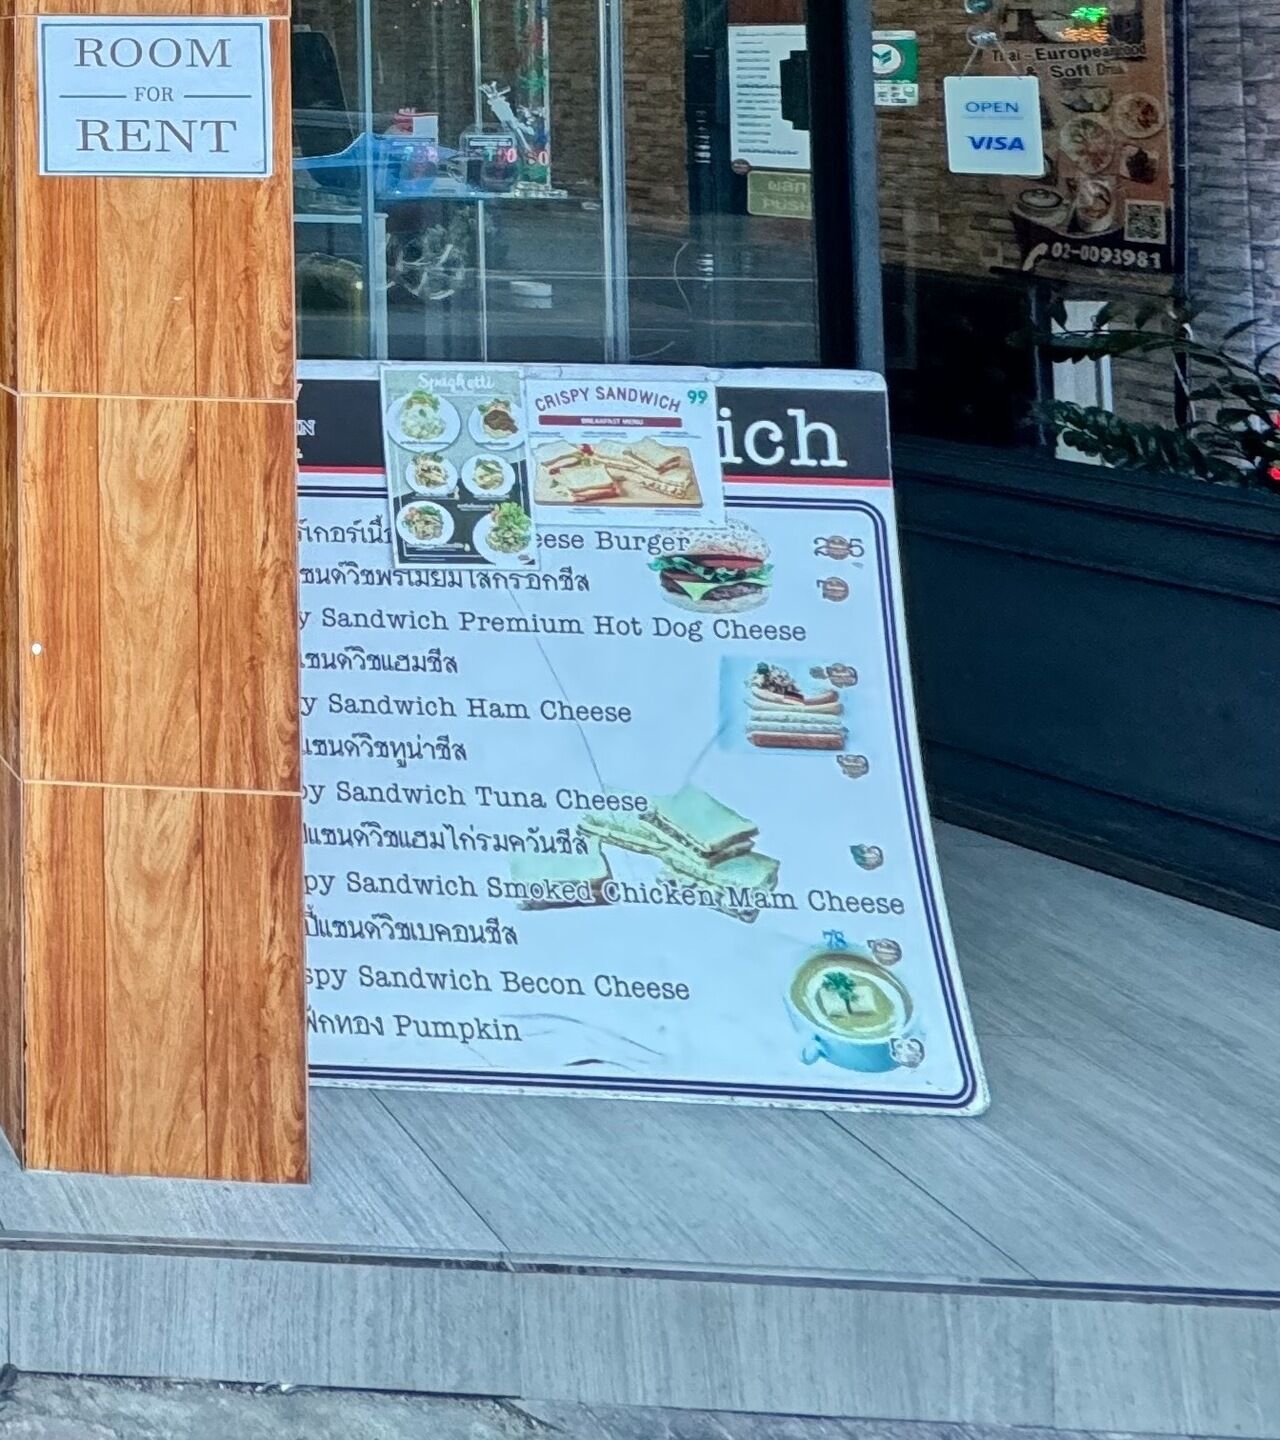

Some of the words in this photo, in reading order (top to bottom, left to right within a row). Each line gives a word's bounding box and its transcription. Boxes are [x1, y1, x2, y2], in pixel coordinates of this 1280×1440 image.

[73, 37, 231, 68] ROOM
[1050, 63, 1090, 78] Soft
[134, 86, 174, 102] FOR
[964, 101, 1019, 113] OPEN
[75, 119, 237, 153] RENT
[966, 136, 1025, 151] VISA
[534, 386, 590, 412] CRISPY
[595, 385, 681, 413] SANDWICH
[686, 389, 708, 405] 99
[594, 530, 690, 556] Burger
[321, 607, 450, 631] Sandwich
[459, 611, 584, 635] Premium
[593, 615, 642, 636] Hot
[652, 616, 704, 642] Dog
[712, 618, 807, 642] Cheese
[328, 693, 458, 718] Sandwich
[466, 697, 531, 720] Ham
[540, 699, 632, 723] Cheese
[336, 781, 466, 807] Sandwich
[475, 785, 547, 809] Tuna
[555, 788, 649, 812] Cheese
[346, 871, 479, 898] Sandwich
[487, 877, 593, 902] Smoked
[603, 880, 716, 906] Chicken
[807, 889, 906, 915] Cheese
[358, 964, 493, 993] Sandwich
[499, 970, 585, 997] Becon
[593, 974, 691, 1001] Cheese
[393, 1013, 523, 1044] Pumpkin
